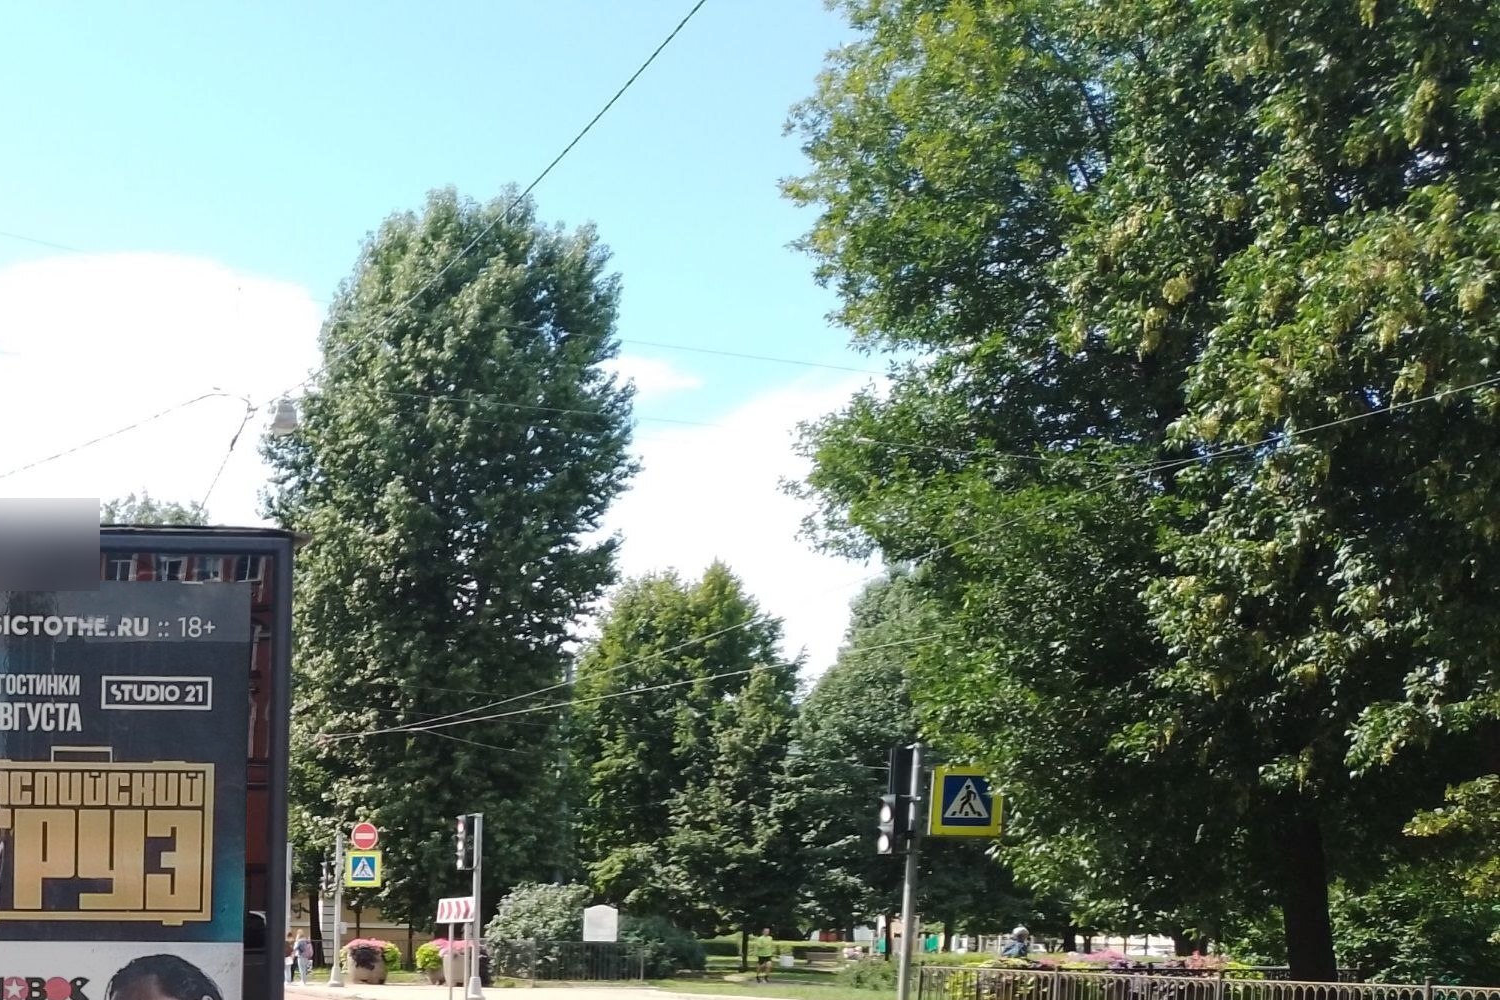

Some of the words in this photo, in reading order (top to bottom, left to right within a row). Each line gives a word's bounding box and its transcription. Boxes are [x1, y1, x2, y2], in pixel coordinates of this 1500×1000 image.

[177, 616, 216, 637] 18+
[110, 684, 180, 702] STUDIO
[184, 684, 204, 702] 21
